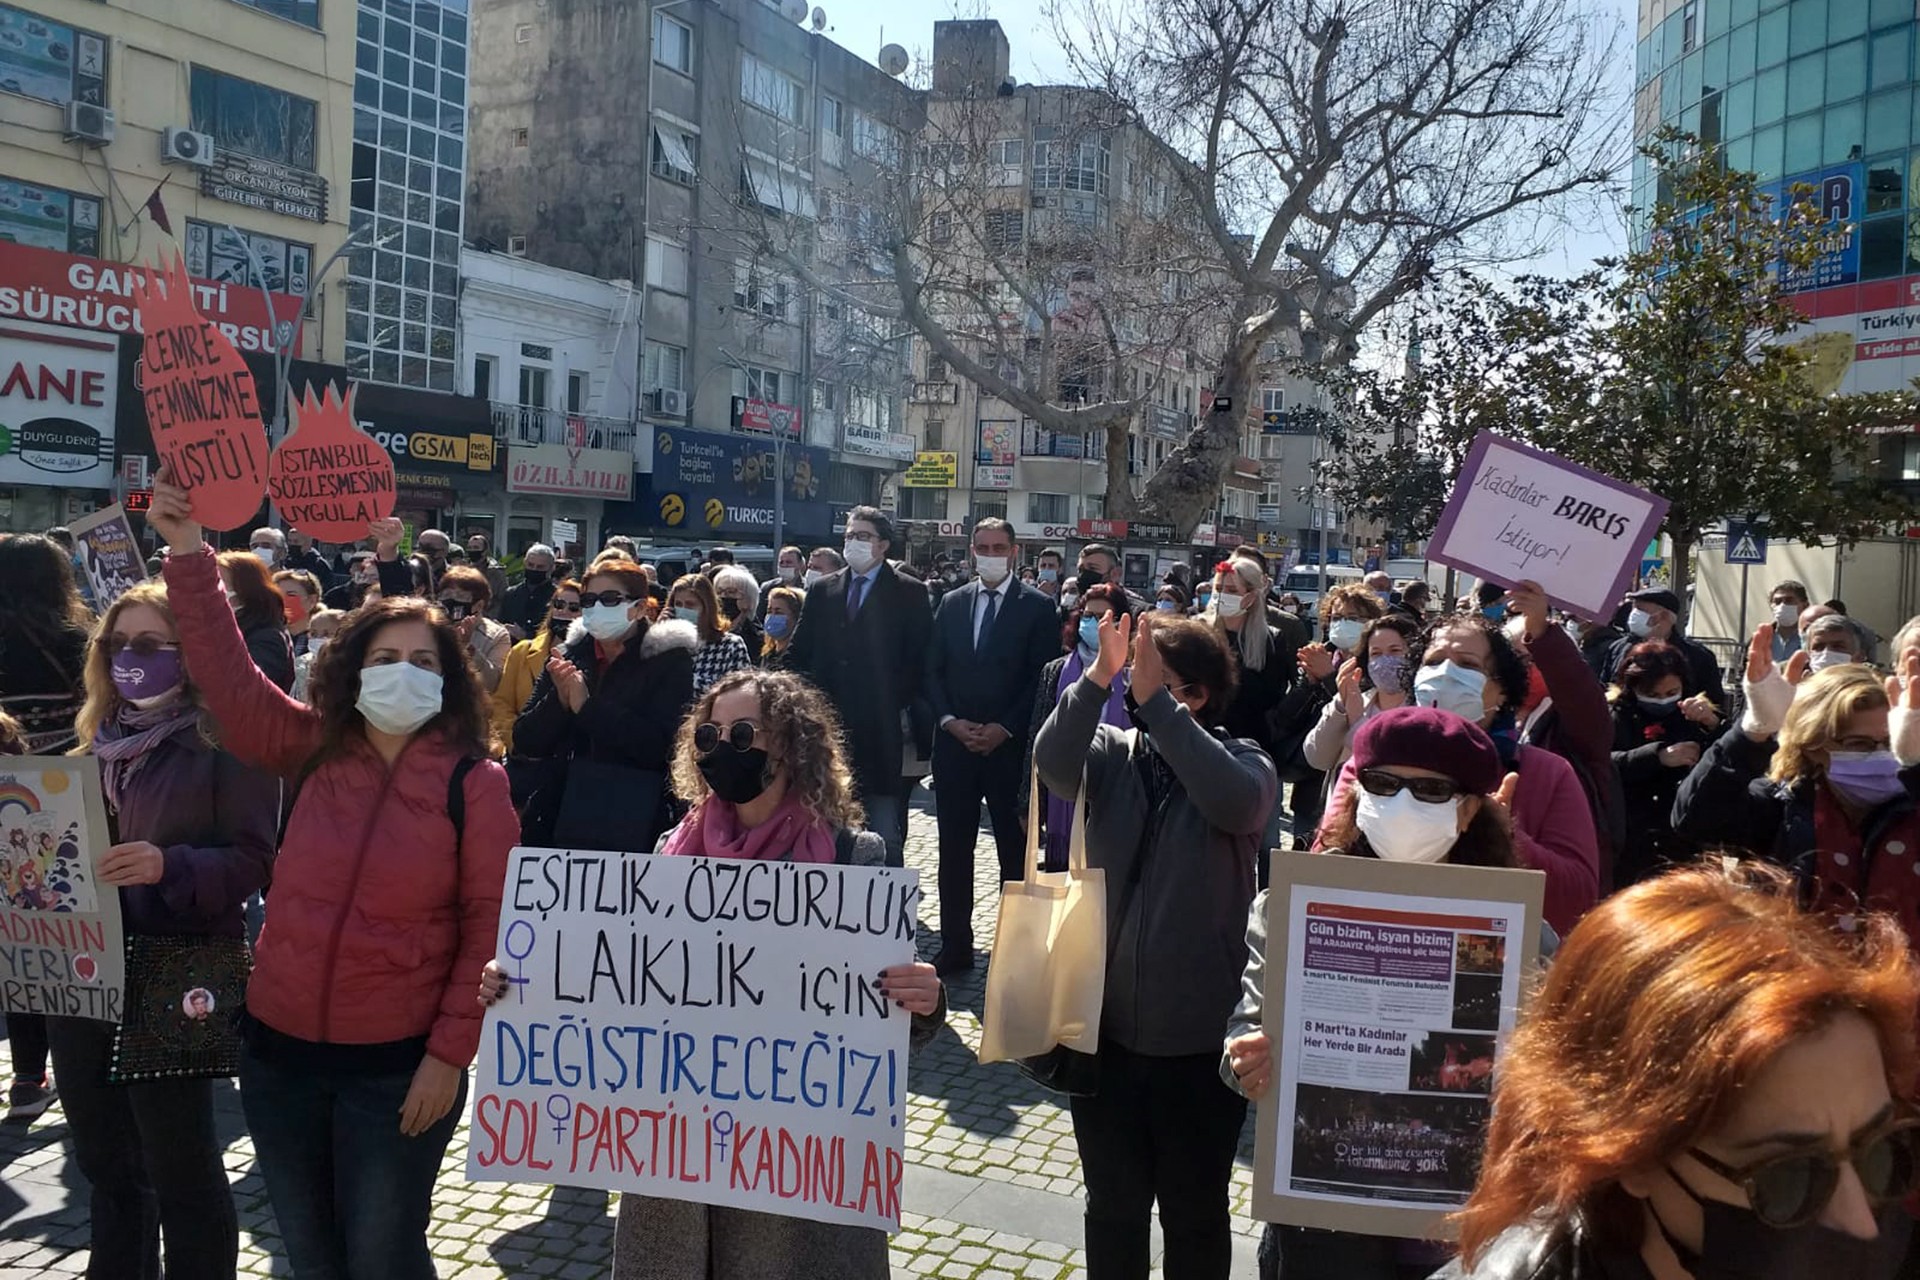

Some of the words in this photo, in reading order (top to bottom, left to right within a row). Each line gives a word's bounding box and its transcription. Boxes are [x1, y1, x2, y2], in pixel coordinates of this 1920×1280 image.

[23, 431, 63, 443] DUYGU
[412, 436, 456, 459] GSM
[726, 506, 788, 526] TURKCEL
[684, 858, 919, 942] ÖZGÜRLÜK
[1309, 922, 1334, 936] Gün
[1378, 929, 1411, 944] isyan
[1304, 1020, 1313, 1031] 8
[1303, 1036, 1323, 1047] Her
[1325, 1039, 1355, 1052] Yerde
[1357, 1043, 1373, 1054] Bir
[1374, 1045, 1406, 1057] Arada
[496, 1014, 898, 1127] DEĞİŞTİRECEĞİZ!
[477, 1093, 553, 1171] SOL
[729, 1119, 904, 1220] KADINLAR
